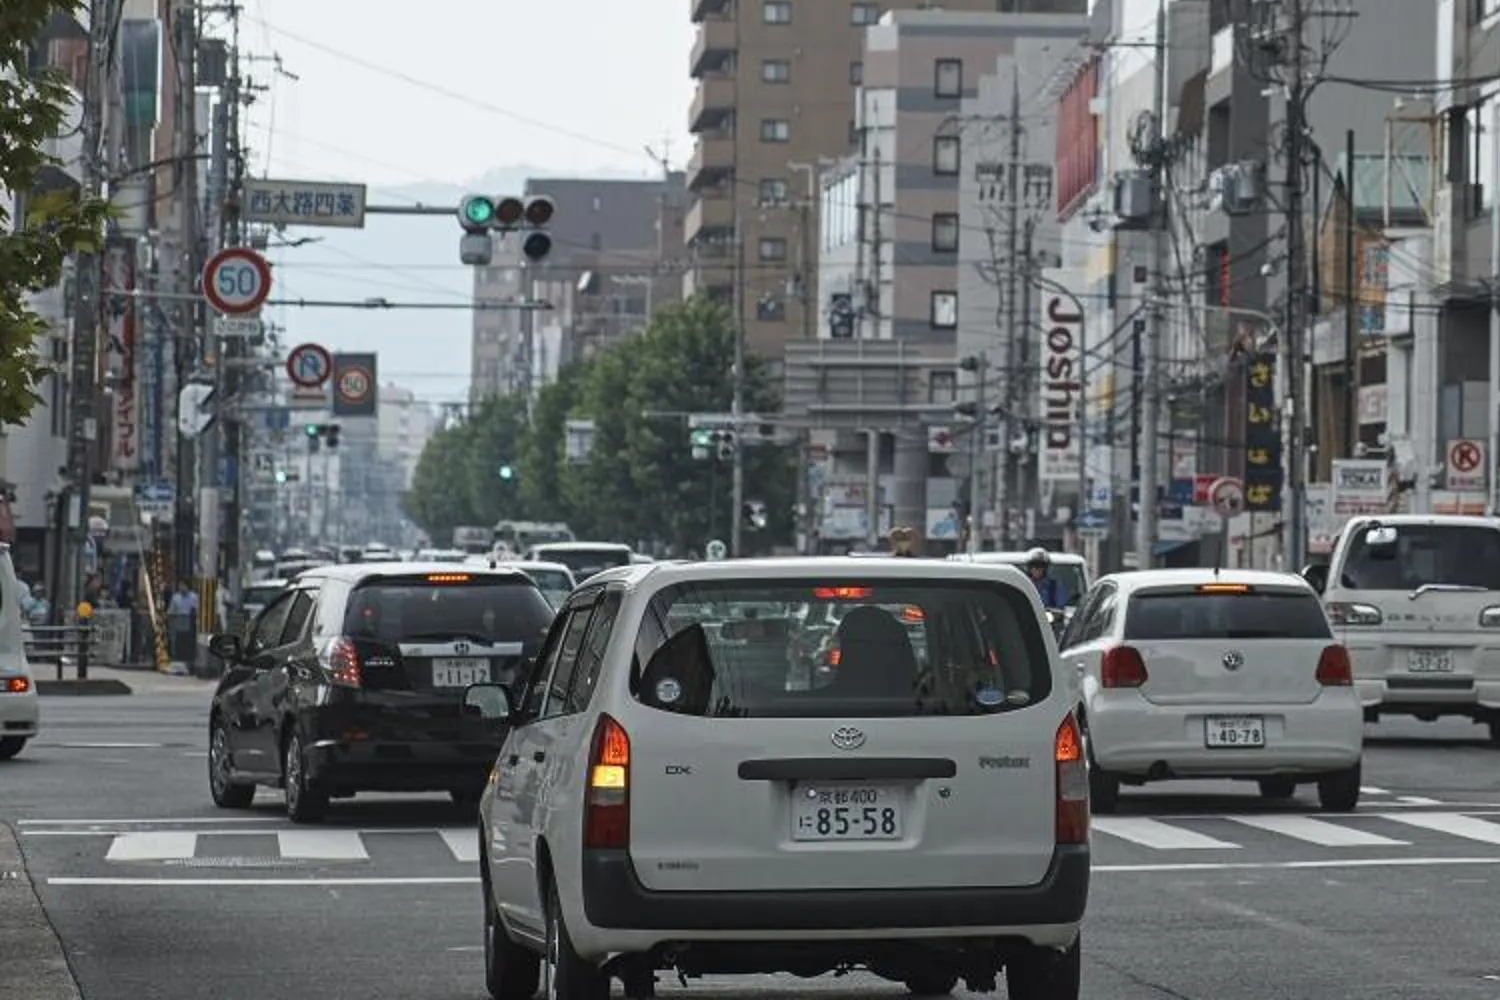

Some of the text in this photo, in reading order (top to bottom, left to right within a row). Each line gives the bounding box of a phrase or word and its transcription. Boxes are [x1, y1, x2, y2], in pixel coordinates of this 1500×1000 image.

[219, 266, 256, 297] 50
[1047, 296, 1082, 449] Joshin
[817, 807, 896, 835] 85-58
